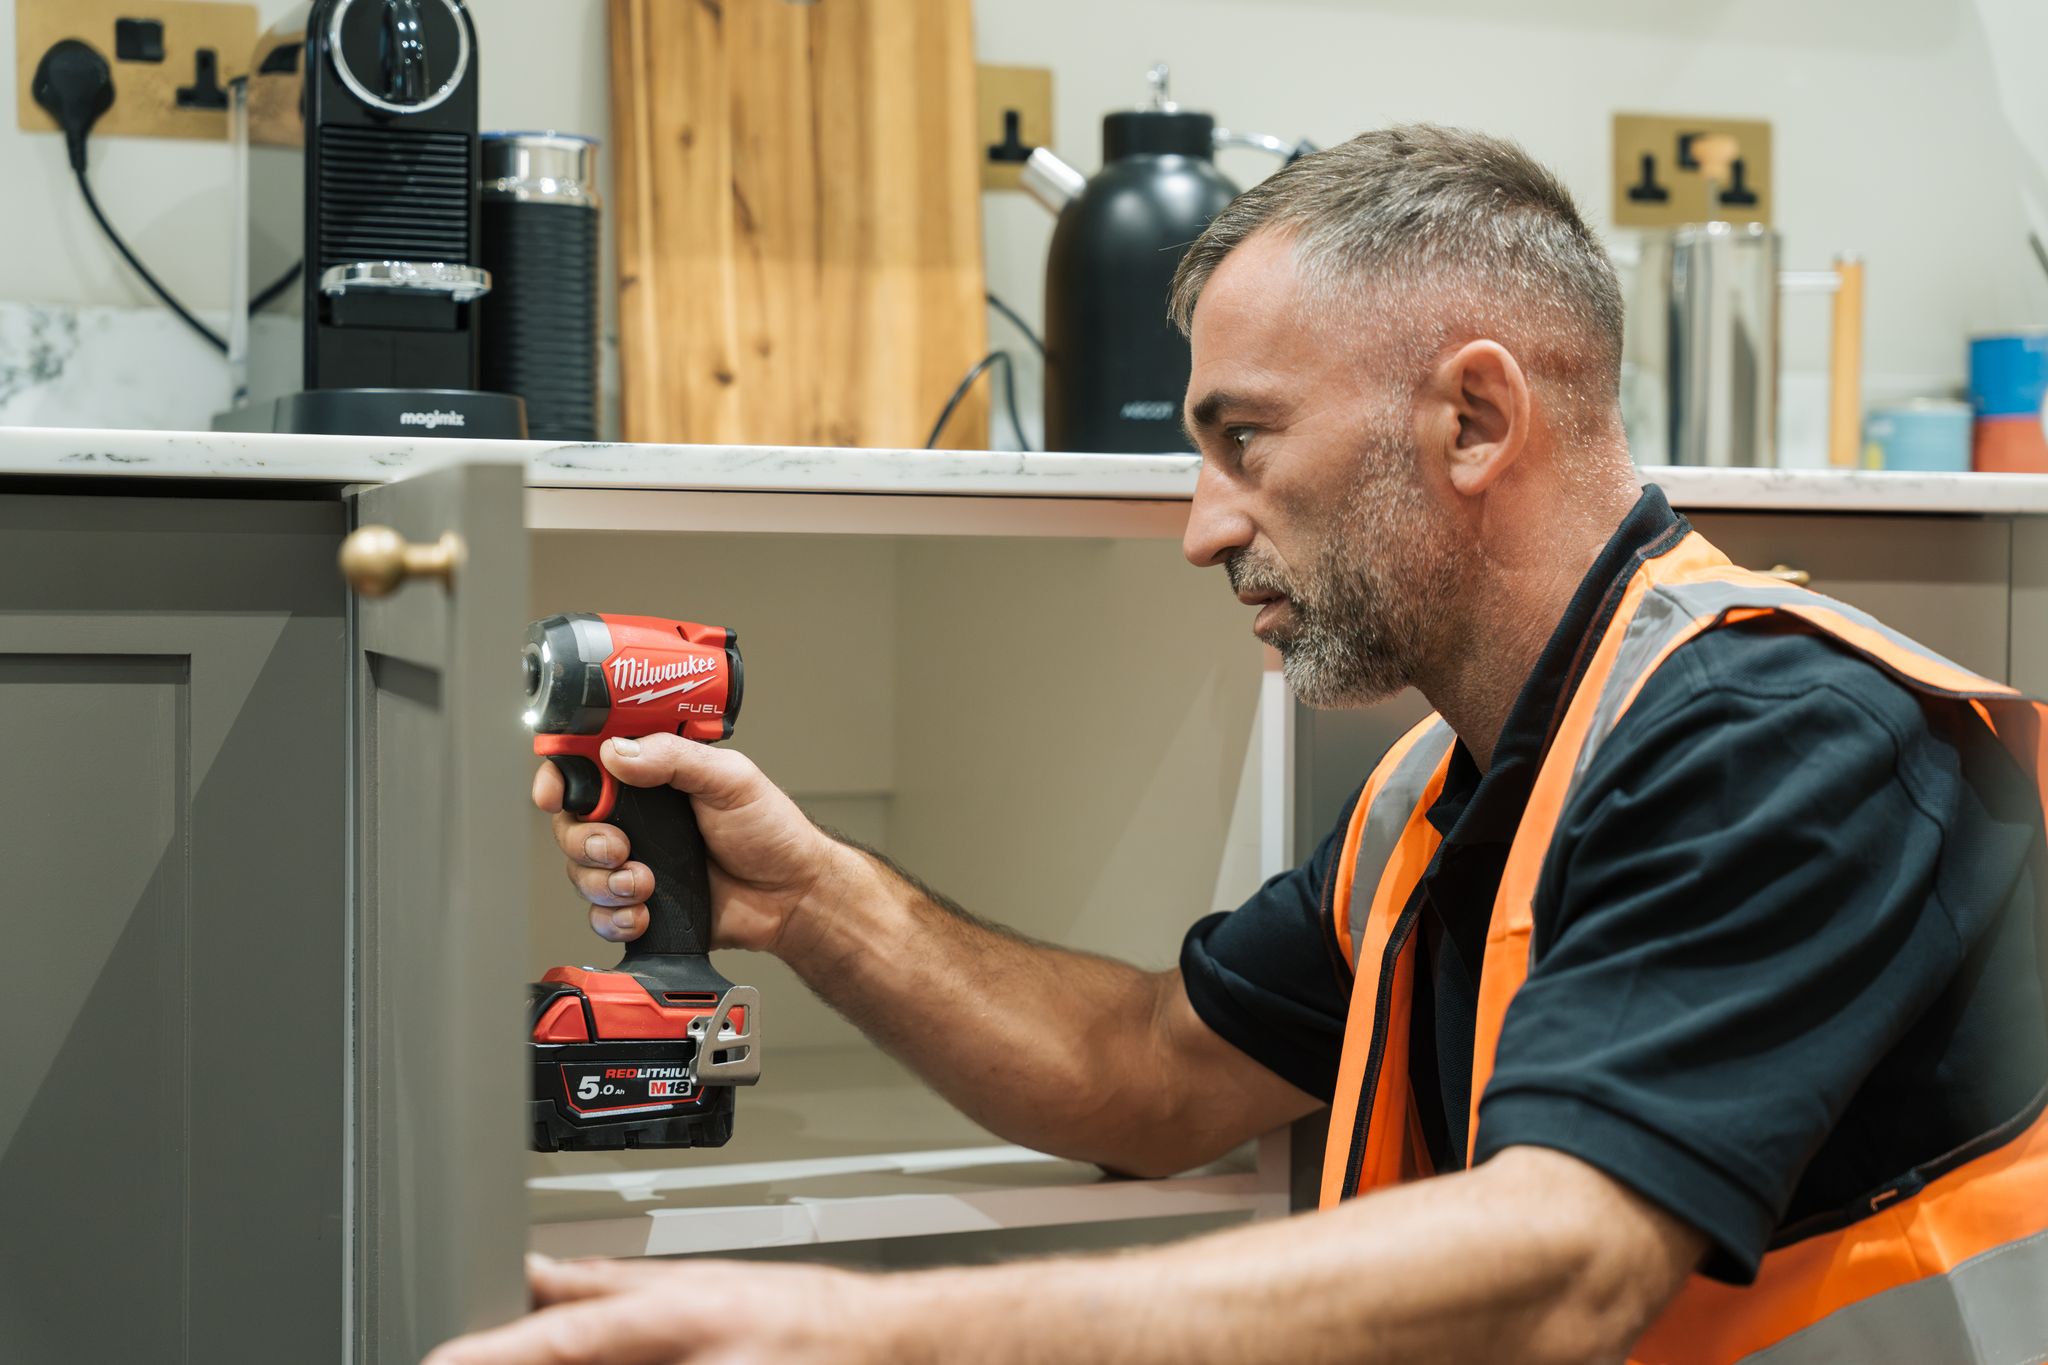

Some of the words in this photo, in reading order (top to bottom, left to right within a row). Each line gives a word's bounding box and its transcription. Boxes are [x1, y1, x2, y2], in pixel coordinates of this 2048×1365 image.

[400, 409, 465, 429] magimix
[610, 654, 718, 691] Milwaukee
[677, 703, 723, 714] FUEL
[577, 1075, 614, 1100] 5.0
[614, 1087, 625, 1096] Ah
[650, 1081, 690, 1095] M18
